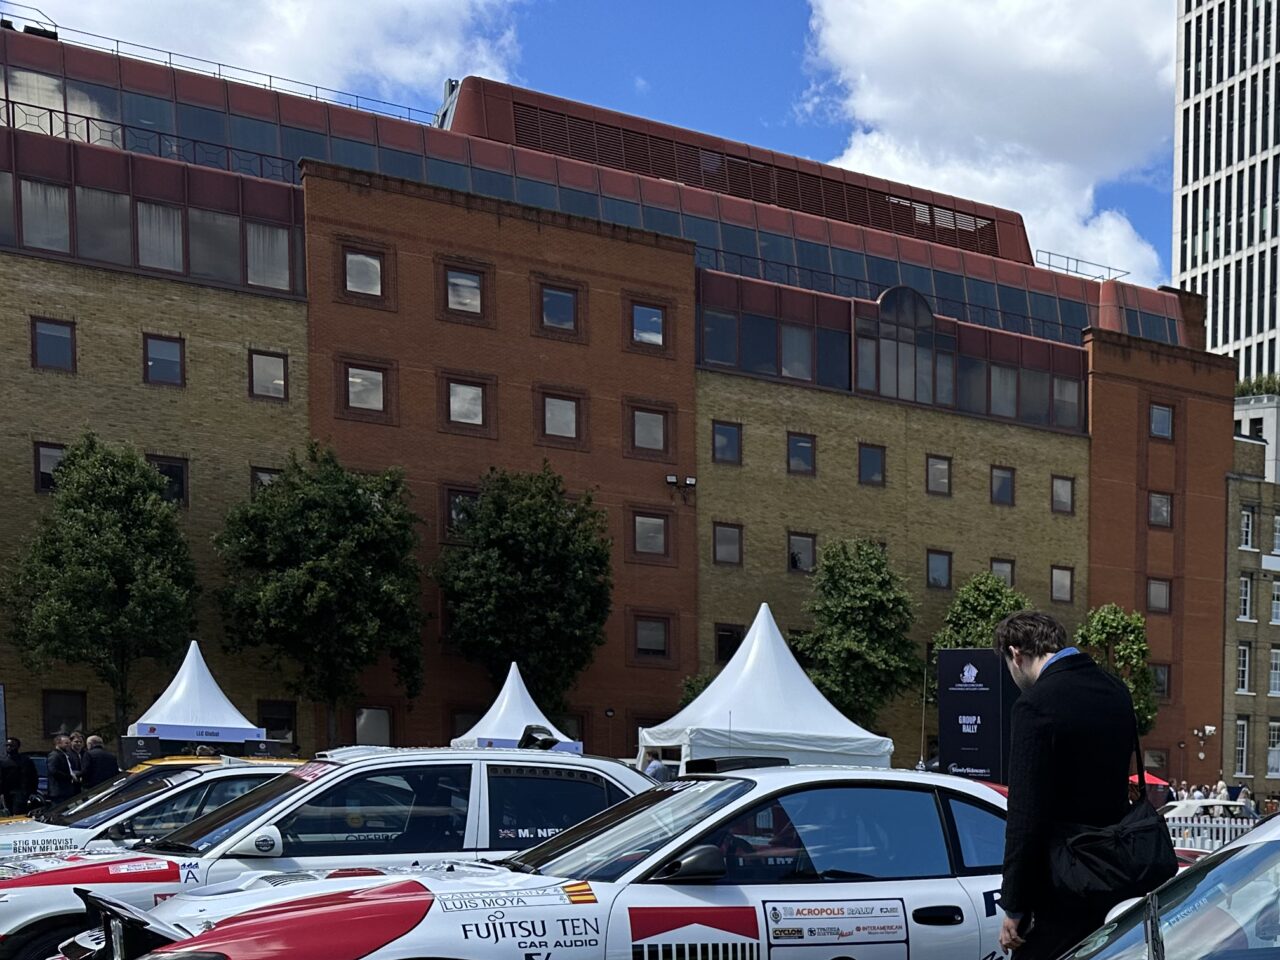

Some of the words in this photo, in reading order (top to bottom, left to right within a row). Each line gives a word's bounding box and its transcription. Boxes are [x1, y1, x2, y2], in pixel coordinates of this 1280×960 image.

[958, 716, 976, 724] GROUP
[962, 724, 978, 733] RALLY
[518, 828, 534, 838] M.
[32, 838, 74, 846] BLOMQVIST
[13, 846, 36, 854] BENNY
[184, 870, 200, 884] A
[444, 899, 478, 911] LUIS
[482, 897, 527, 908] MOYA
[796, 908, 844, 917] ACROPOLIS
[847, 907, 874, 916] RALLY
[461, 919, 546, 944] FUJITSU
[556, 918, 600, 936] TEN
[774, 928, 803, 936] CYCLON
[554, 939, 598, 948] AUDIO
